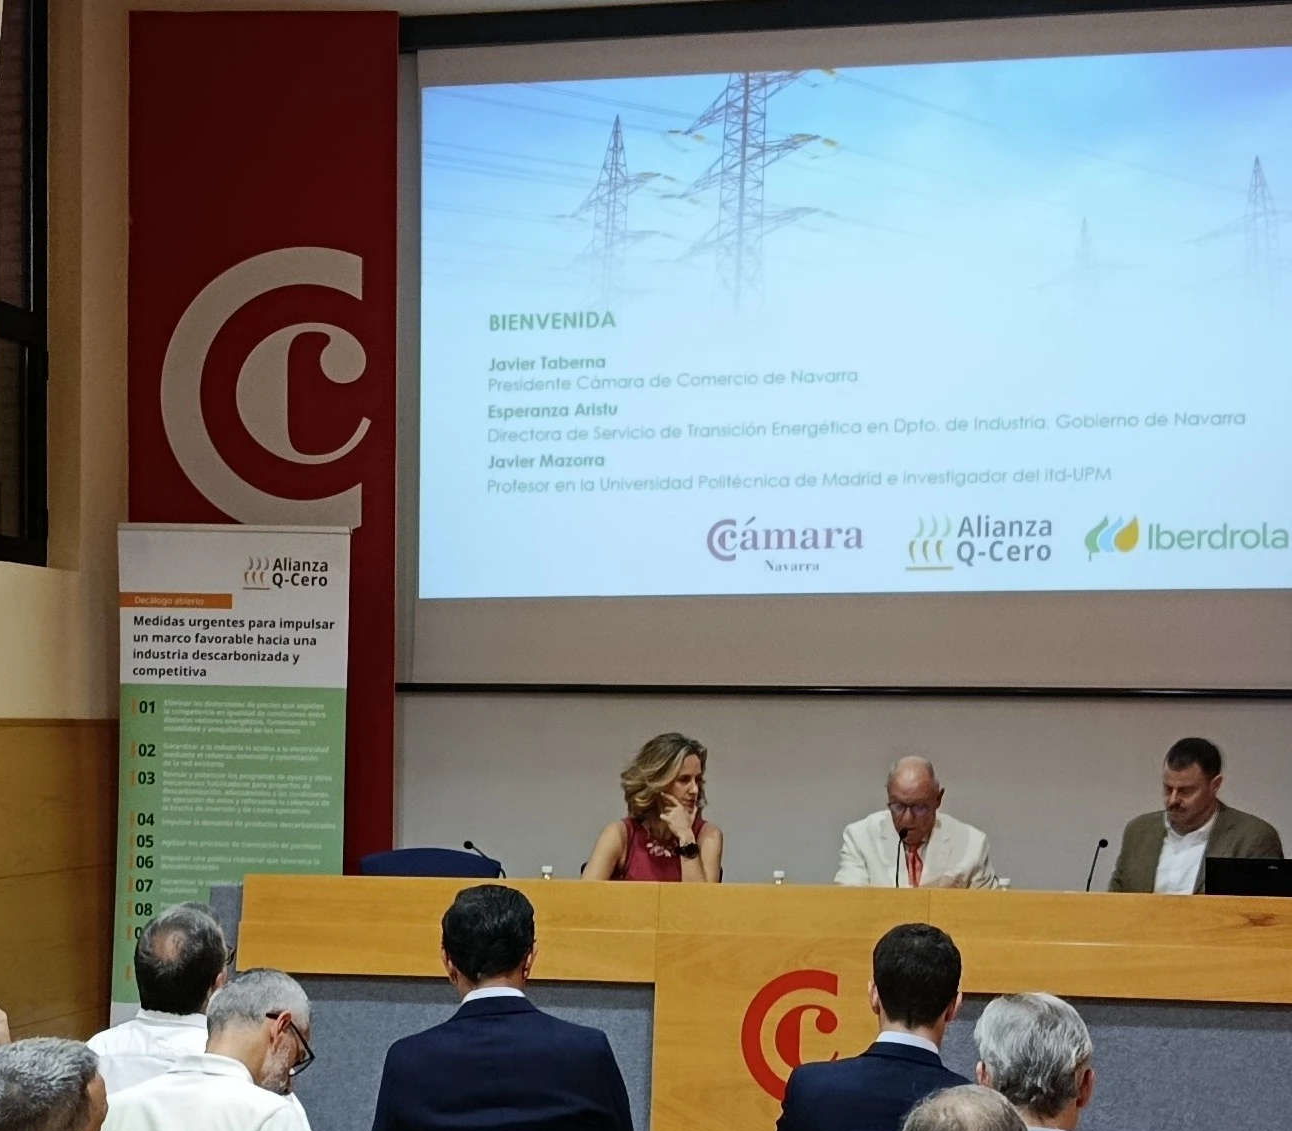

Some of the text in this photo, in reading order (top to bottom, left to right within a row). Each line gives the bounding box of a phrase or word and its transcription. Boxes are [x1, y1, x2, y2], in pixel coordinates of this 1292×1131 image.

[489, 311, 616, 331] BIENVENIDA
[488, 355, 606, 372] Javier Taberna
[488, 369, 859, 393] Presidente Cámara de Comercio de Navarra
[488, 402, 618, 422] Esperanza Aristu
[488, 427, 561, 443] Directora
[567, 426, 588, 441] de
[594, 425, 655, 440] Servicio
[660, 424, 682, 438] de
[687, 422, 766, 438] Transición
[772, 419, 862, 438] Energética
[867, 422, 888, 433] en
[894, 418, 940, 436] Dpto.
[945, 418, 968, 432] de
[1055, 414, 1139, 429] Gobierno
[1144, 413, 1168, 427] de
[1173, 412, 1246, 426] Navarra
[487, 454, 605, 471] Javier Mazorra
[487, 479, 550, 494] Profesor
[555, 482, 575, 492] en
[581, 477, 595, 491] la
[600, 475, 693, 491] Universidad
[698, 473, 790, 489] Politécnica
[794, 472, 817, 487] de
[822, 471, 882, 487] Madrid
[887, 475, 898, 486] e
[903, 469, 1007, 487] investigador
[1012, 468, 1040, 483] del
[957, 515, 1052, 538] Alianza
[1148, 522, 1289, 550] Iberdrola
[957, 540, 1052, 567] Q-Cero
[272, 557, 328, 572] Alianza
[764, 560, 819, 571] Navarra
[272, 573, 328, 587] Q-Cero
[133, 616, 335, 631] Medidas urgentes para impulsar
[133, 633, 317, 646] un marco favorable hacia una
[133, 649, 300, 664] industria descarbonizada y
[133, 665, 207, 679] competitiva
[139, 700, 156, 714] 01
[138, 743, 156, 757] 02
[138, 771, 155, 785] 03
[137, 812, 155, 826] 04
[136, 835, 154, 848] 05
[136, 855, 154, 869] 06
[135, 879, 153, 893] 07
[135, 902, 153, 916] 08
